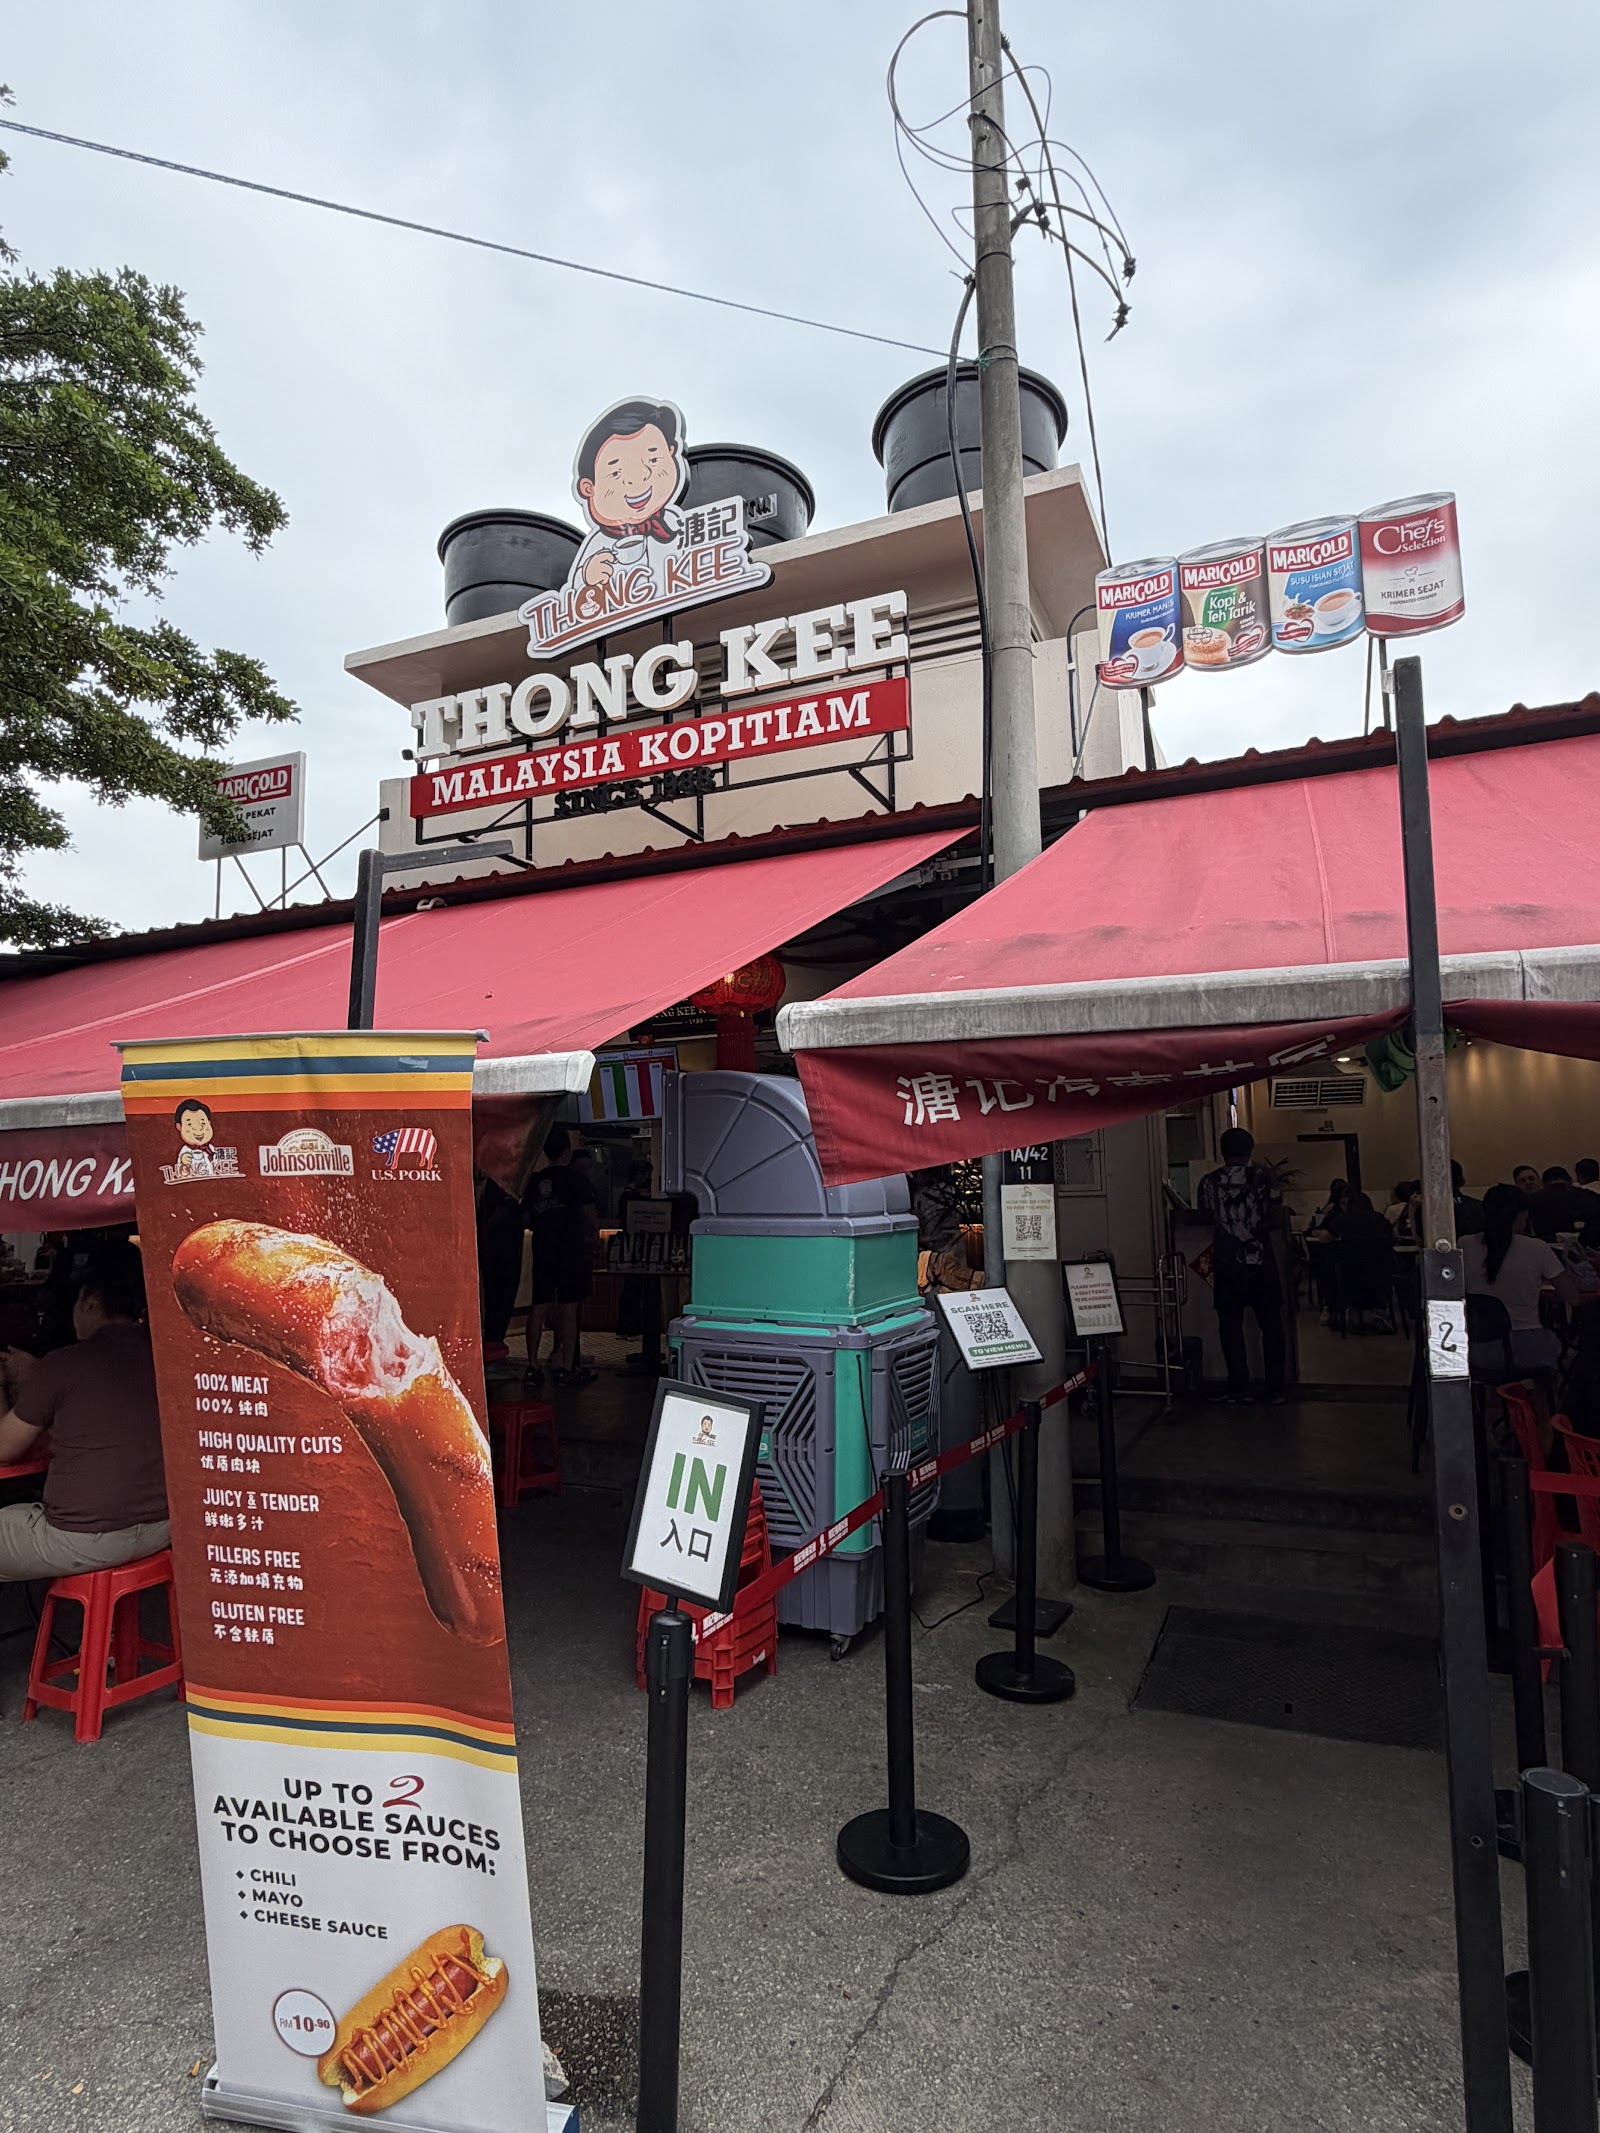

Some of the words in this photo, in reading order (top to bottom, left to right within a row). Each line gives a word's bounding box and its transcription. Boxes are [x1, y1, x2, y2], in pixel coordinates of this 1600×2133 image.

[1373, 518, 1446, 555] Chef's
[1401, 535, 1446, 553] Selection
[1272, 535, 1349, 570] MARIGOLD
[1183, 555, 1257, 587] MARIGOLD
[1290, 575, 1310, 586] SUSU
[1333, 561, 1355, 576] SEJAT
[526, 568, 655, 640] THONG
[665, 540, 742, 596] KEE
[1101, 574, 1170, 607] MARIGOLD
[1209, 592, 1236, 611] Kopi
[1238, 591, 1247, 604] &
[1381, 588, 1415, 600] KRIMER
[1417, 579, 1446, 595] SEJAT
[1125, 608, 1151, 621] KRIMER
[1152, 600, 1175, 615] MANIS
[1207, 609, 1227, 624] Teh
[1228, 600, 1256, 620] Tarik
[411, 640, 699, 757] THONG
[719, 590, 909, 698] KEE
[430, 742, 625, 807] MALAYSIA
[638, 690, 872, 769] KOPITIAM
[554, 779, 643, 817] SINCE
[650, 765, 716, 801] 1988
[245, 807, 277, 820] PEKAT
[246, 828, 274, 841] SEJAT
[676, 1005, 697, 1017] KEE
[159, 1161, 209, 1182] THONG
[210, 1159, 239, 1176] KEE
[263, 1147, 351, 1174] Johnsonville
[0, 1157, 97, 1202] HONG
[96, 1156, 136, 1196] K
[371, 1169, 397, 1181] U.S.
[398, 1169, 443, 1182] PORK
[1019, 1165, 1032, 1181] 11
[950, 1305, 980, 1314] SCAN
[982, 1301, 1010, 1311] HERE
[984, 1345, 1004, 1354] VIEW
[1005, 1342, 1028, 1351] MENU
[1438, 1321, 1457, 1353] 2
[194, 1373, 229, 1392] 100%
[231, 1376, 269, 1395] MEAT
[195, 1397, 233, 1414] 100%
[238, 1401, 268, 1417] 纯肉
[198, 1430, 233, 1450] HIGH
[236, 1434, 296, 1454] QUALITY
[300, 1436, 343, 1454] CUTS
[200, 1455, 261, 1474] 优质肉块
[666, 1452, 727, 1523] IN
[203, 1488, 242, 1508] JUICY
[246, 1491, 257, 1510] &
[260, 1493, 320, 1512] TENDER
[204, 1511, 264, 1531] 鲜嫩多汁
[660, 1517, 713, 1563] 入口
[207, 1544, 261, 1566] FILLERS
[264, 1550, 301, 1569] FREE
[210, 1568, 304, 1591] 无添加填充物
[211, 1601, 265, 1623] GLUTEN
[268, 1606, 305, 1626] FREE
[214, 1624, 275, 1645] 不含麸质
[283, 1777, 323, 1801] UP
[332, 1783, 374, 1806] TO
[382, 1774, 425, 1811] 2
[213, 1795, 375, 1832] AVAILABLE
[385, 1813, 501, 1851] SAUCES
[221, 1821, 259, 1845] TO
[268, 1827, 392, 1860] CHOOSE
[402, 1841, 497, 1876] FROM:
[250, 1869, 297, 1887] CHILI
[252, 1889, 304, 1908] MAYO
[254, 1909, 322, 1931] CHEESE
[327, 1920, 389, 1940] SAUCE
